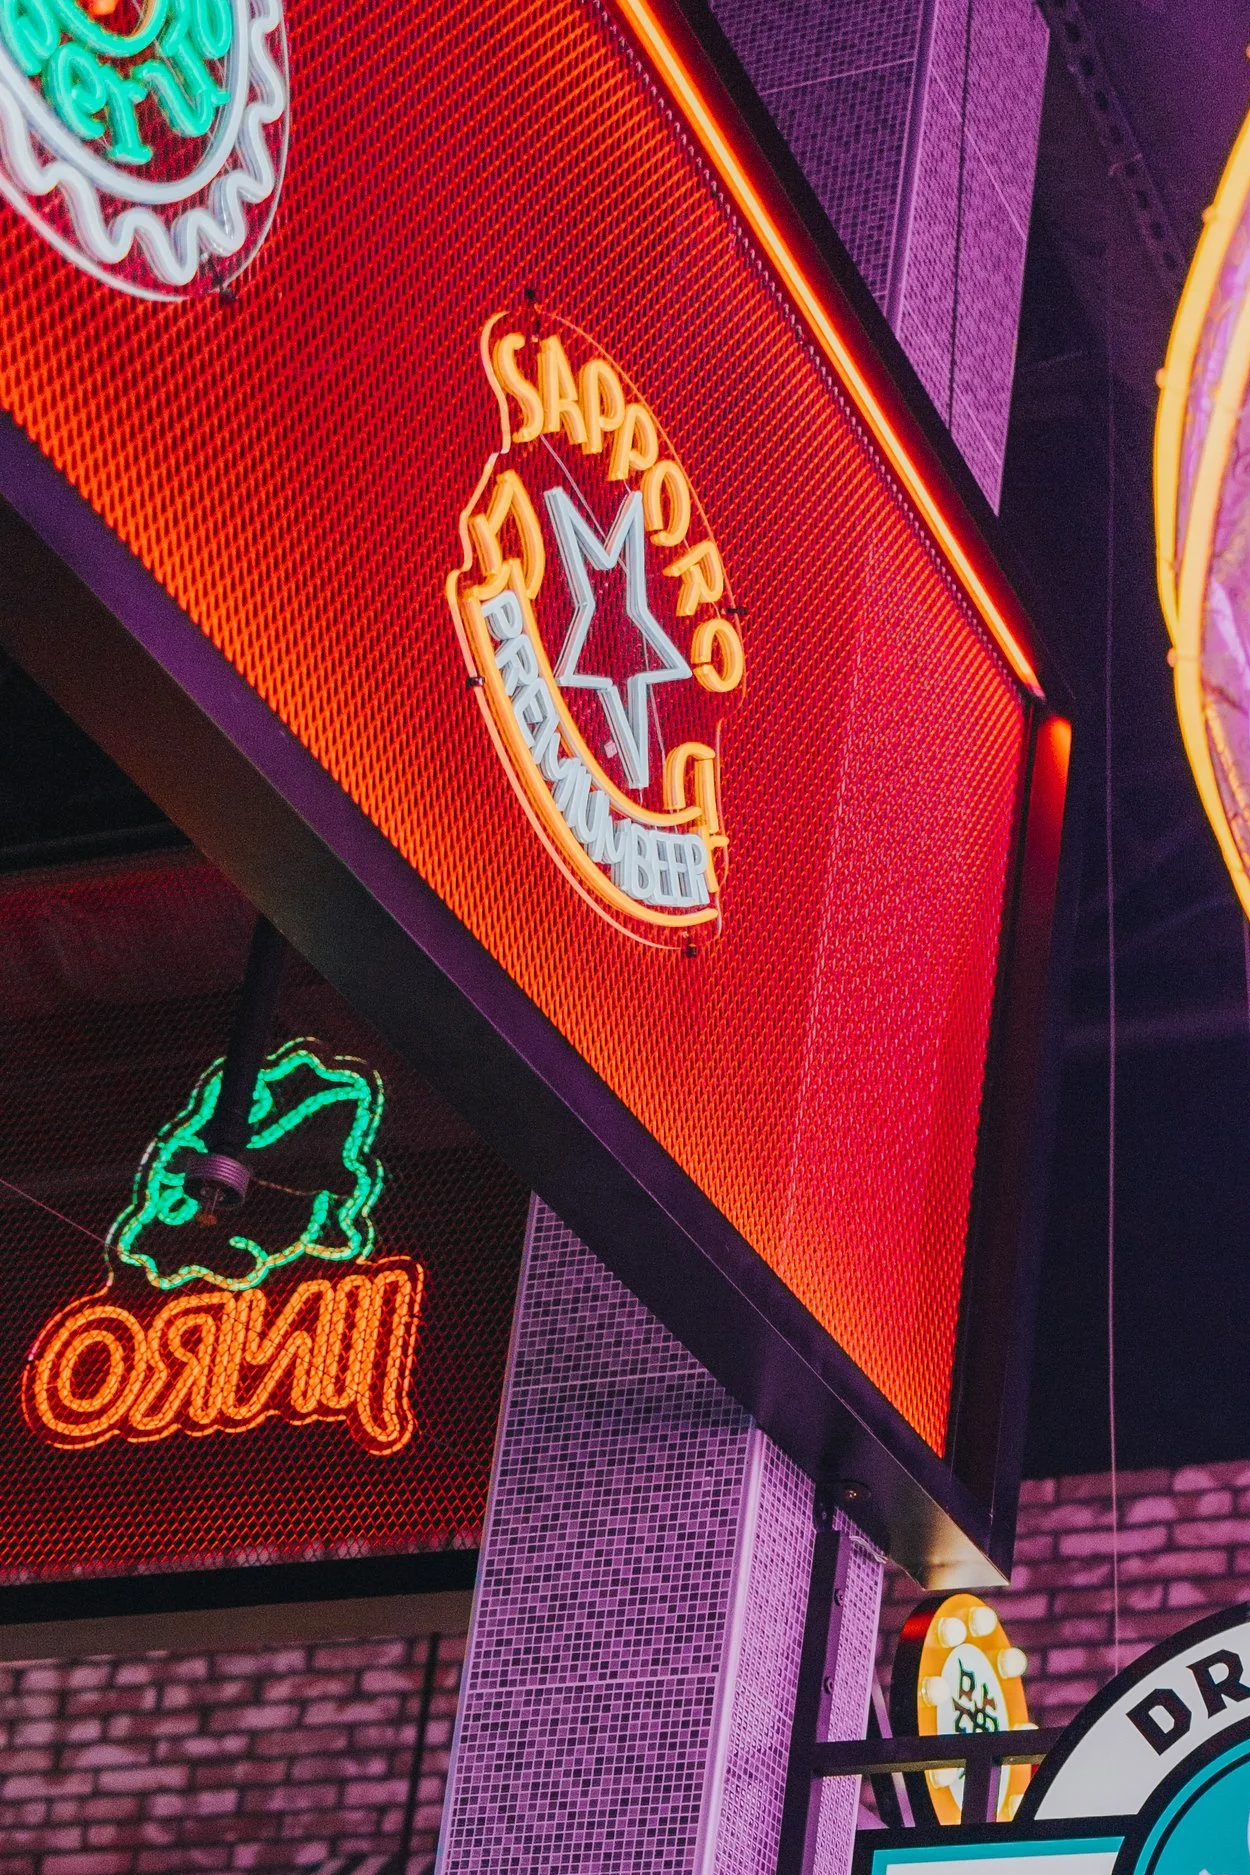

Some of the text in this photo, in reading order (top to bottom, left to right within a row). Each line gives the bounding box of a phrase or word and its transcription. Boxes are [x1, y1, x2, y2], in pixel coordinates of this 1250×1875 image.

[492, 332, 744, 693] SAPPORO
[481, 590, 710, 908] PREMIUM BEER
